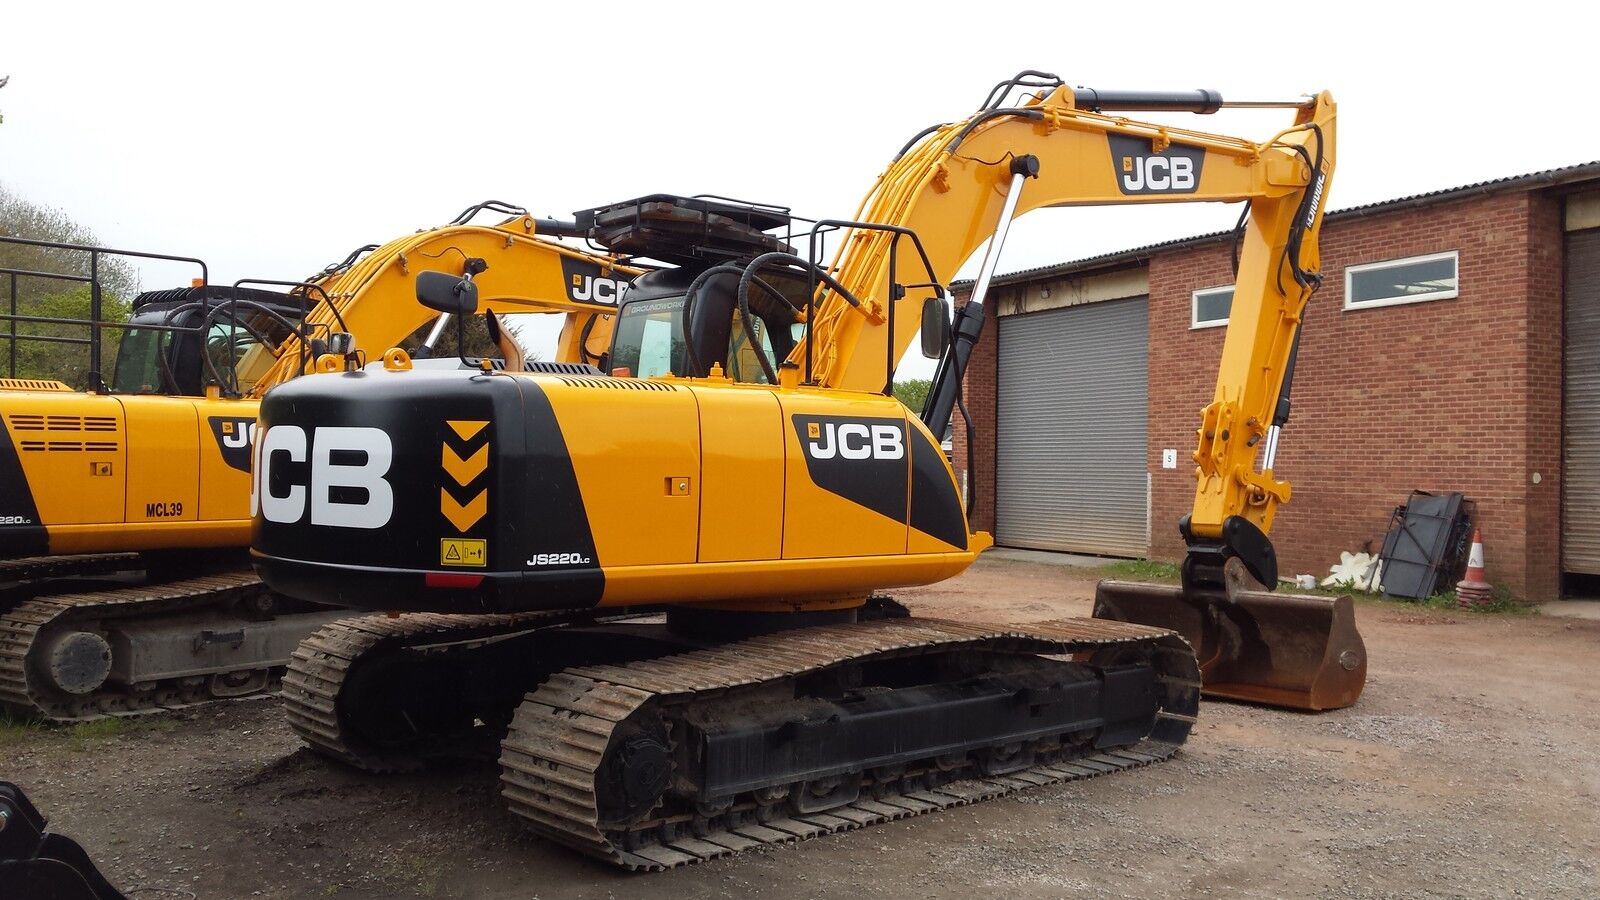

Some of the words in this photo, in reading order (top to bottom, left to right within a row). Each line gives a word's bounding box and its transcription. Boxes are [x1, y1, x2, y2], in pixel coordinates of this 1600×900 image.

[1123, 156, 1195, 191] JCB
[809, 423, 904, 460] JCB
[146, 502, 183, 518] MCL39
